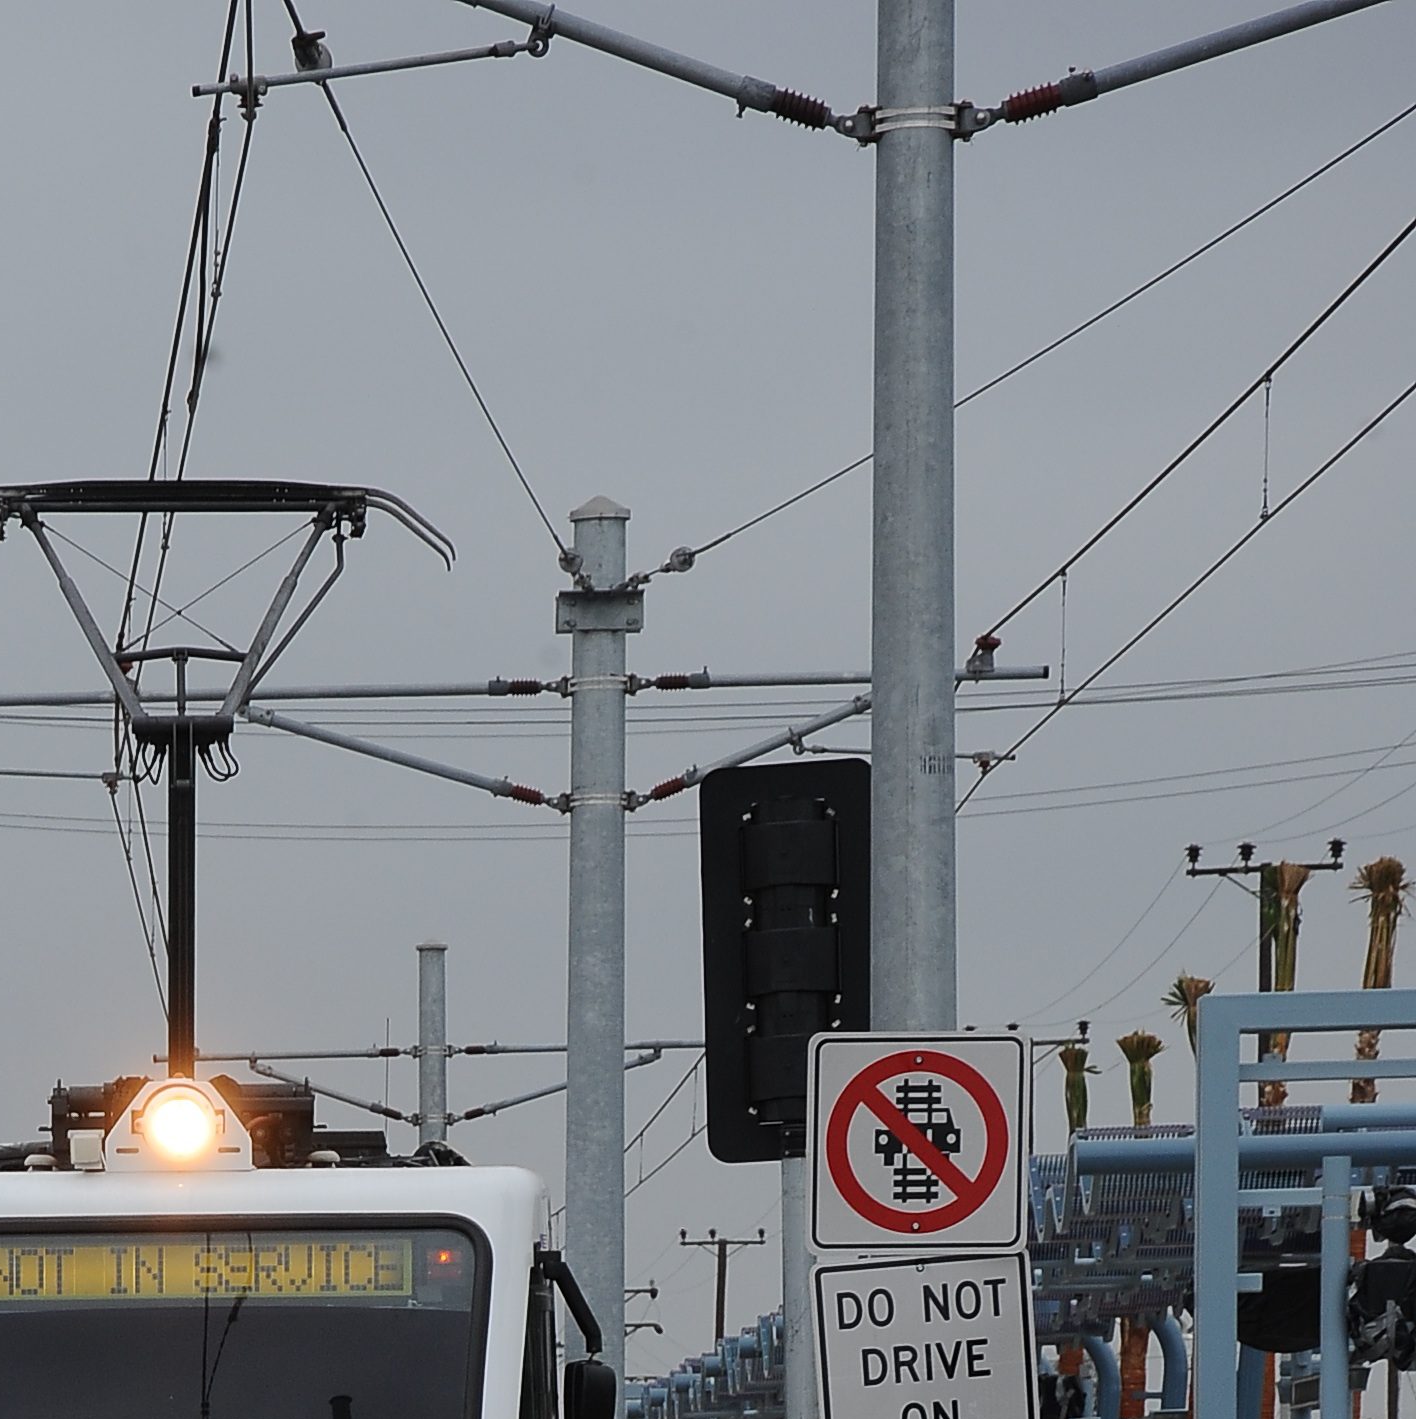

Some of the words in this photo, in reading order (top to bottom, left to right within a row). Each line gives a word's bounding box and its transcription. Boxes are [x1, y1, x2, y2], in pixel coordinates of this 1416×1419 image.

[110, 1247, 164, 1295] IN
[194, 1244, 404, 1293] SERVICE
[836, 1287, 895, 1331] DO
[922, 1277, 1007, 1323] NOT
[861, 1337, 992, 1387] DRIVE
